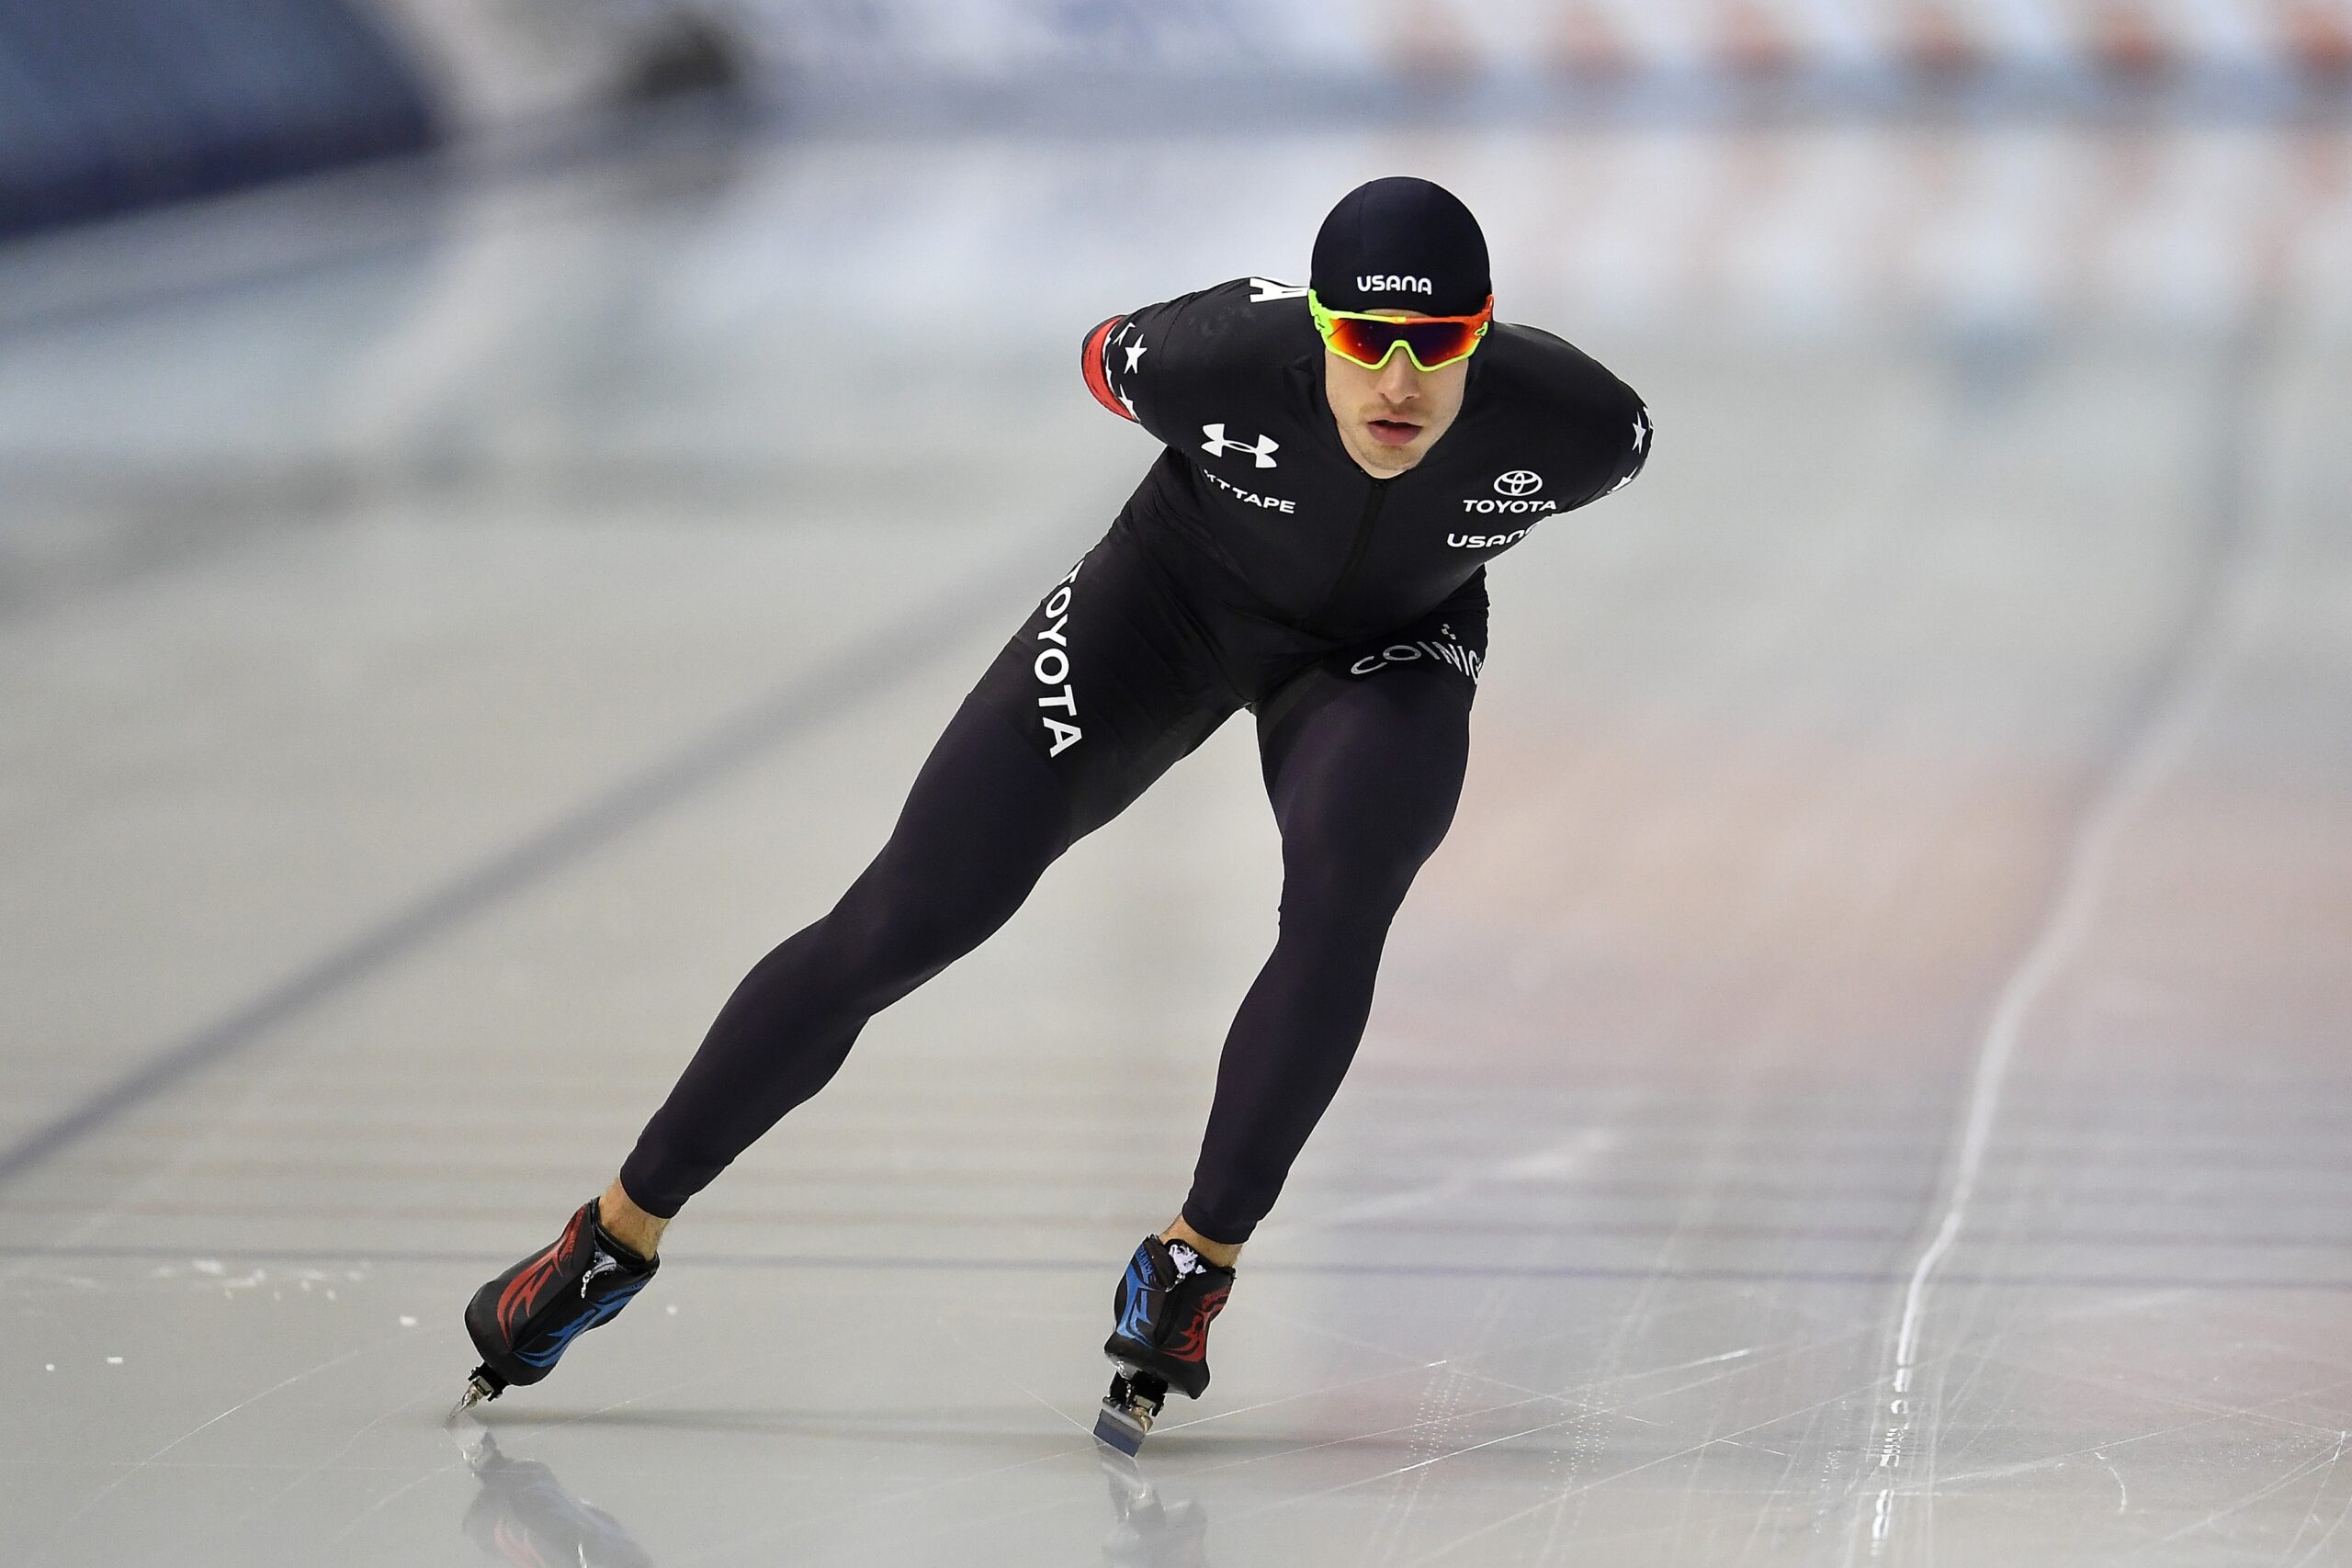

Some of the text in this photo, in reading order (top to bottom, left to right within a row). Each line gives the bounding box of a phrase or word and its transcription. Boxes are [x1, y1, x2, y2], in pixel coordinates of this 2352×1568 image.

[1356, 275, 1432, 295] USANA
[1232, 487, 1296, 514] TAPE
[1463, 500, 1557, 513] TOYOTA
[1447, 525, 1532, 548] USAN
[1034, 558, 1083, 759] TOYOTA
